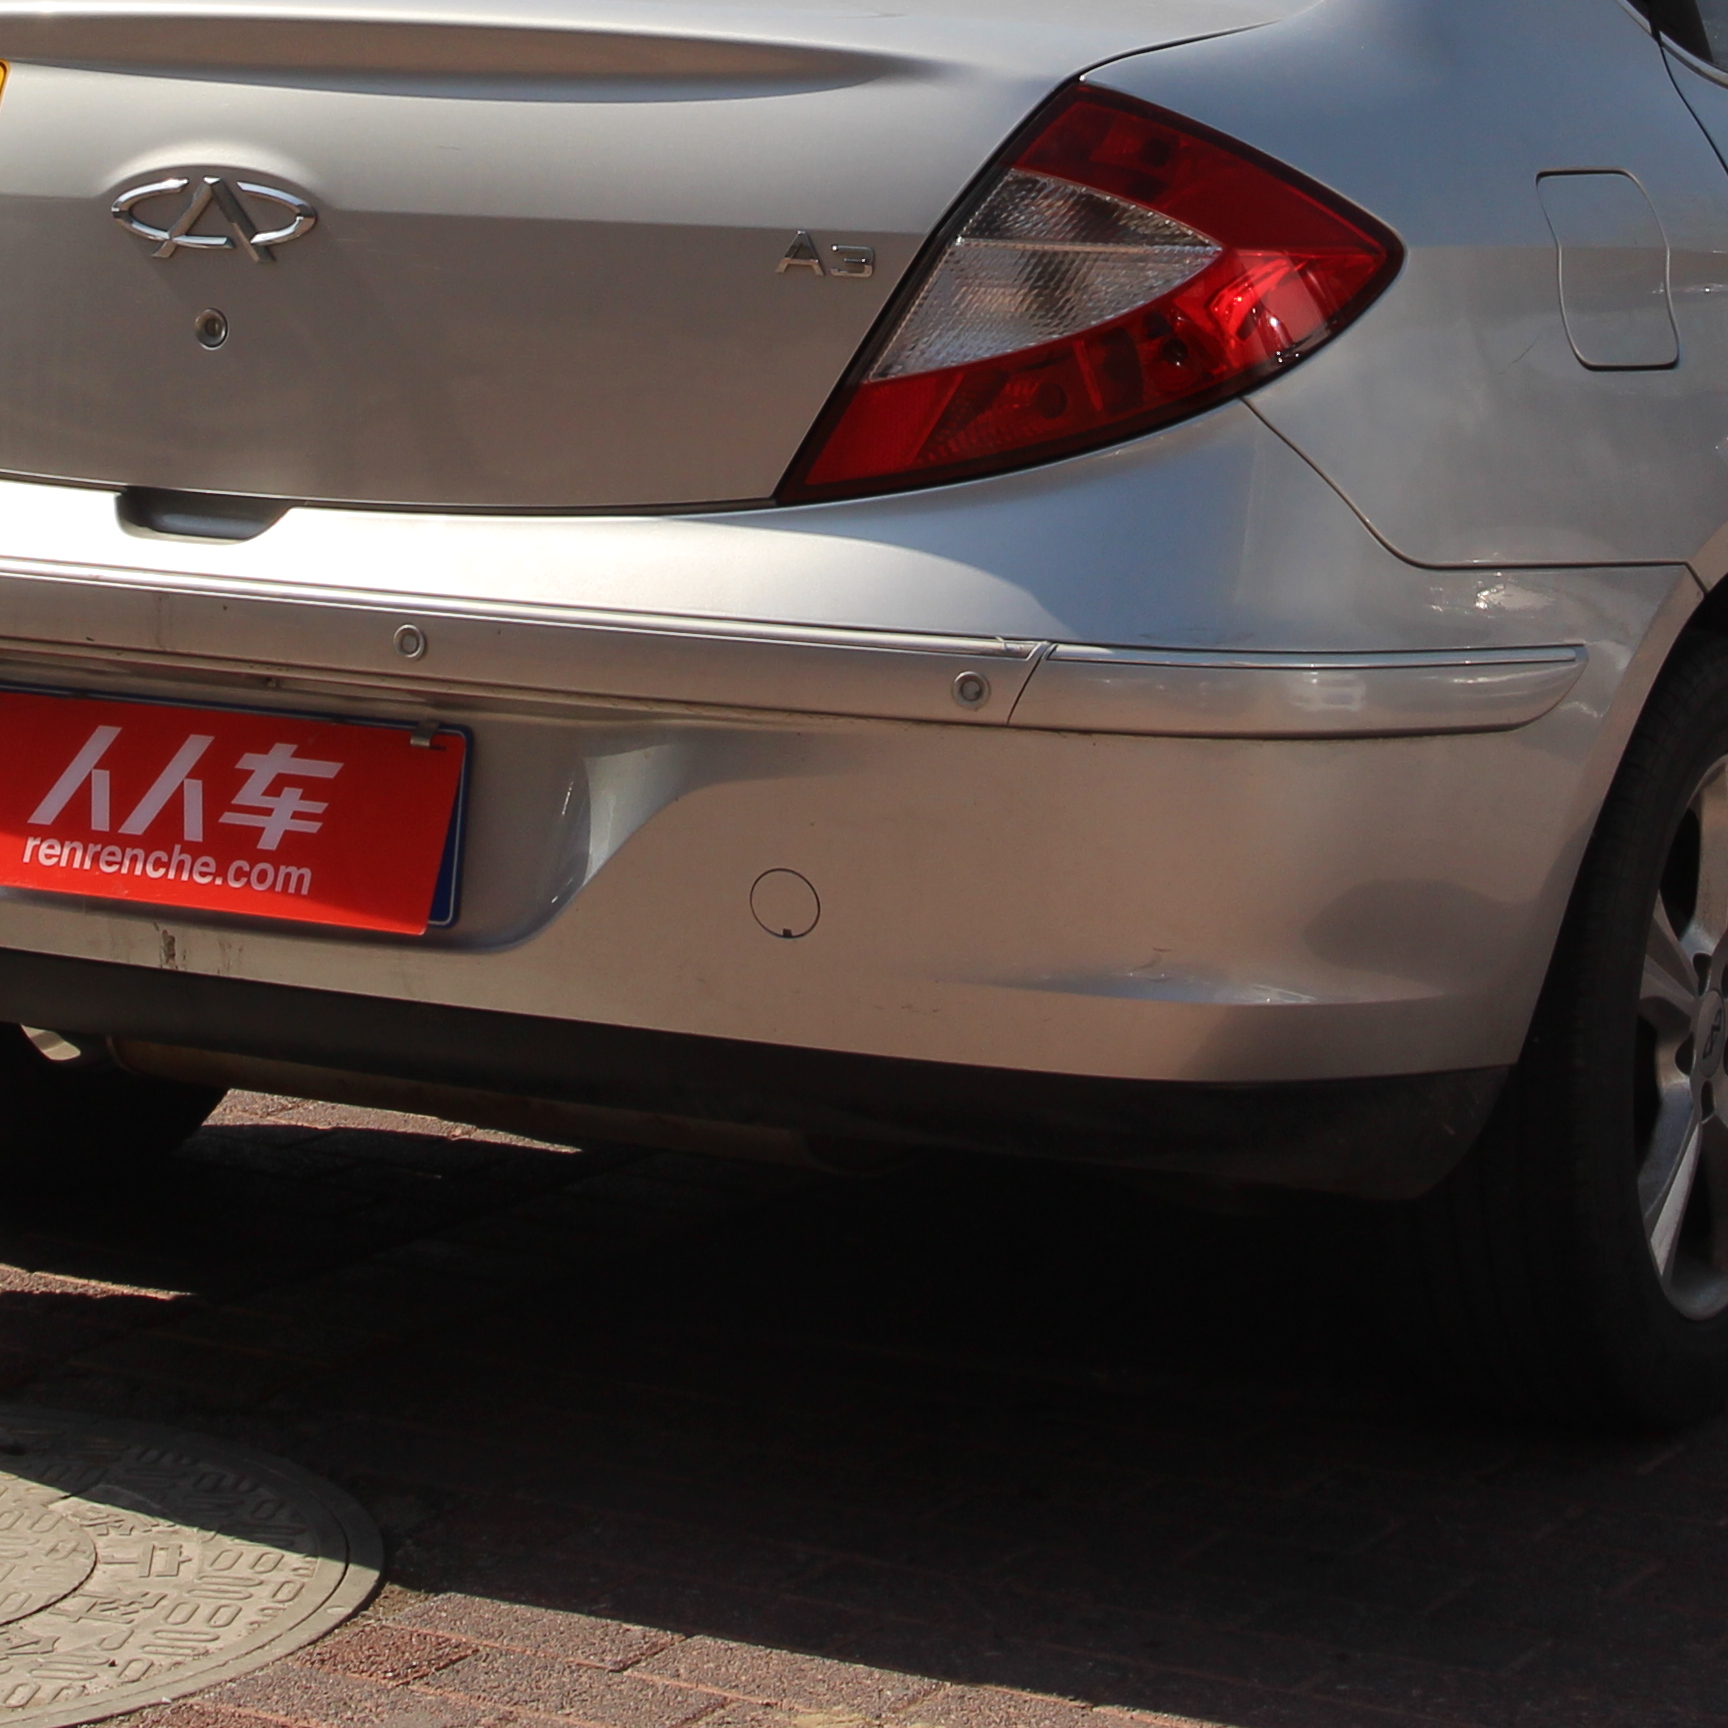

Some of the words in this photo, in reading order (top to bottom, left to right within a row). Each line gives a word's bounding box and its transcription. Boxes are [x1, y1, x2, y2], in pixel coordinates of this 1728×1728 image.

[775, 229, 874, 278] A3
[26, 725, 344, 851] 人人车
[22, 836, 312, 895] renrenche.com
